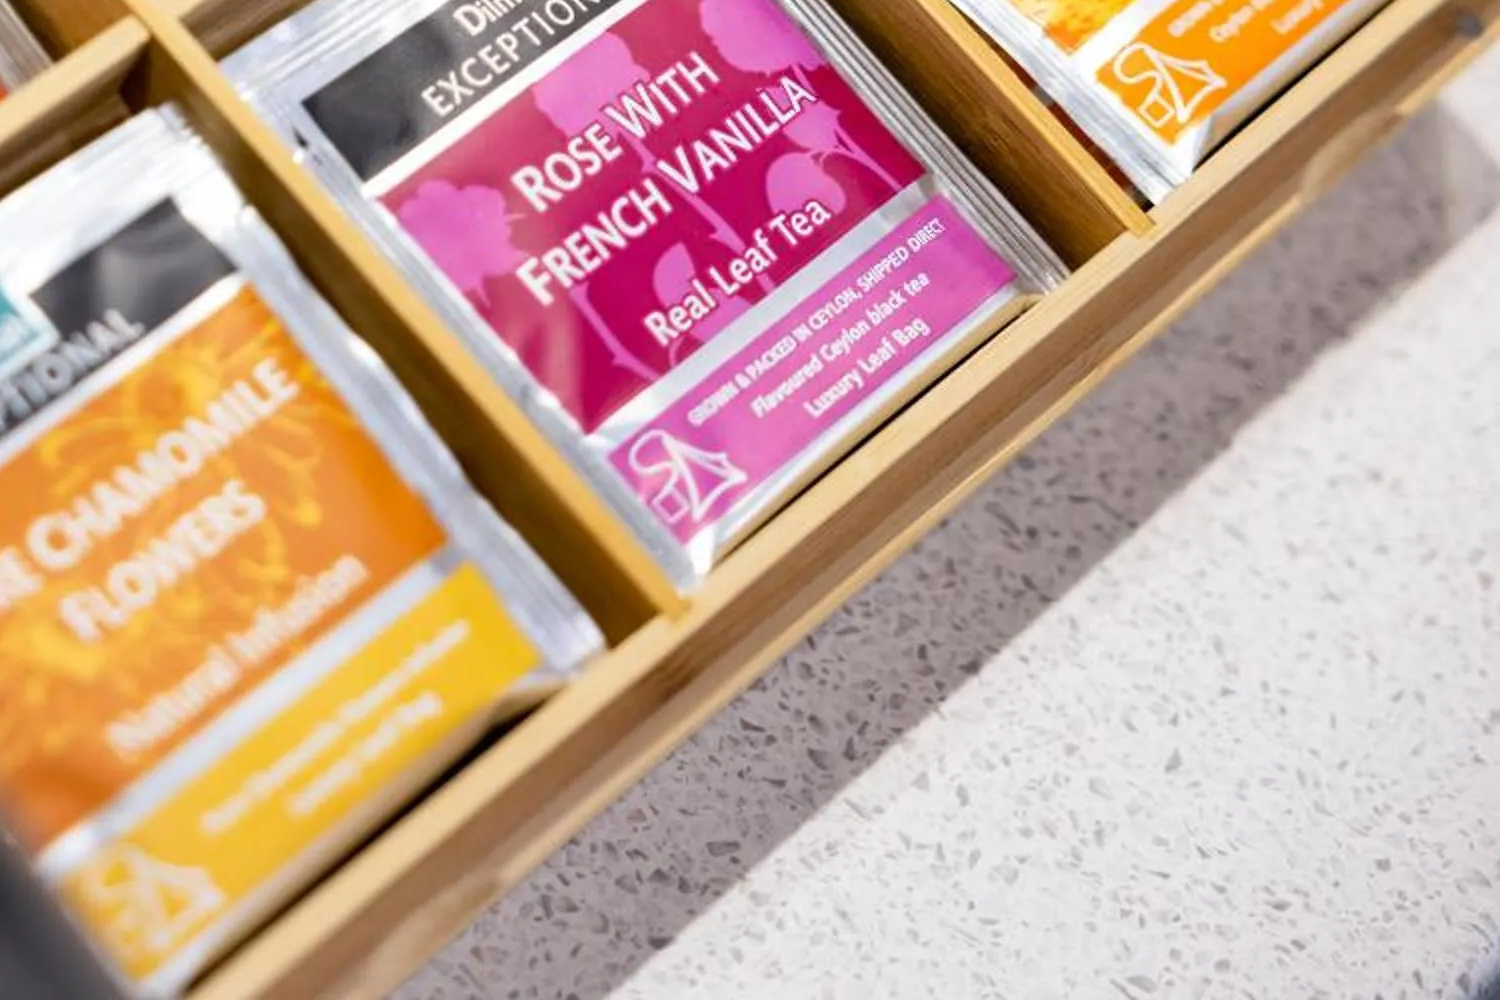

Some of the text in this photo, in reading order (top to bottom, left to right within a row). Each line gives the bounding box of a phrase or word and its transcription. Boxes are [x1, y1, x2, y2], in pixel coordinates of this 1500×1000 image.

[511, 51, 722, 213] ROSE WITH
[515, 76, 817, 306] FRENCH VANILLA
[643, 197, 831, 348] Real Leaf Tea
[734, 372, 751, 391] &
[744, 335, 799, 381] PACKED
[792, 322, 814, 344] IN
[808, 286, 863, 331] CEYLON,
[855, 246, 910, 293] SHIPPED
[906, 217, 946, 254] DIRECT
[750, 272, 931, 419] Flavoured Ceylon black tea
[802, 317, 933, 420] Luxury Leaf Bag
[25, 357, 301, 573] CHAMOMILE
[58, 478, 268, 646] FLOWERS
[108, 645, 241, 764] Natural
[228, 554, 370, 670] Infusion
